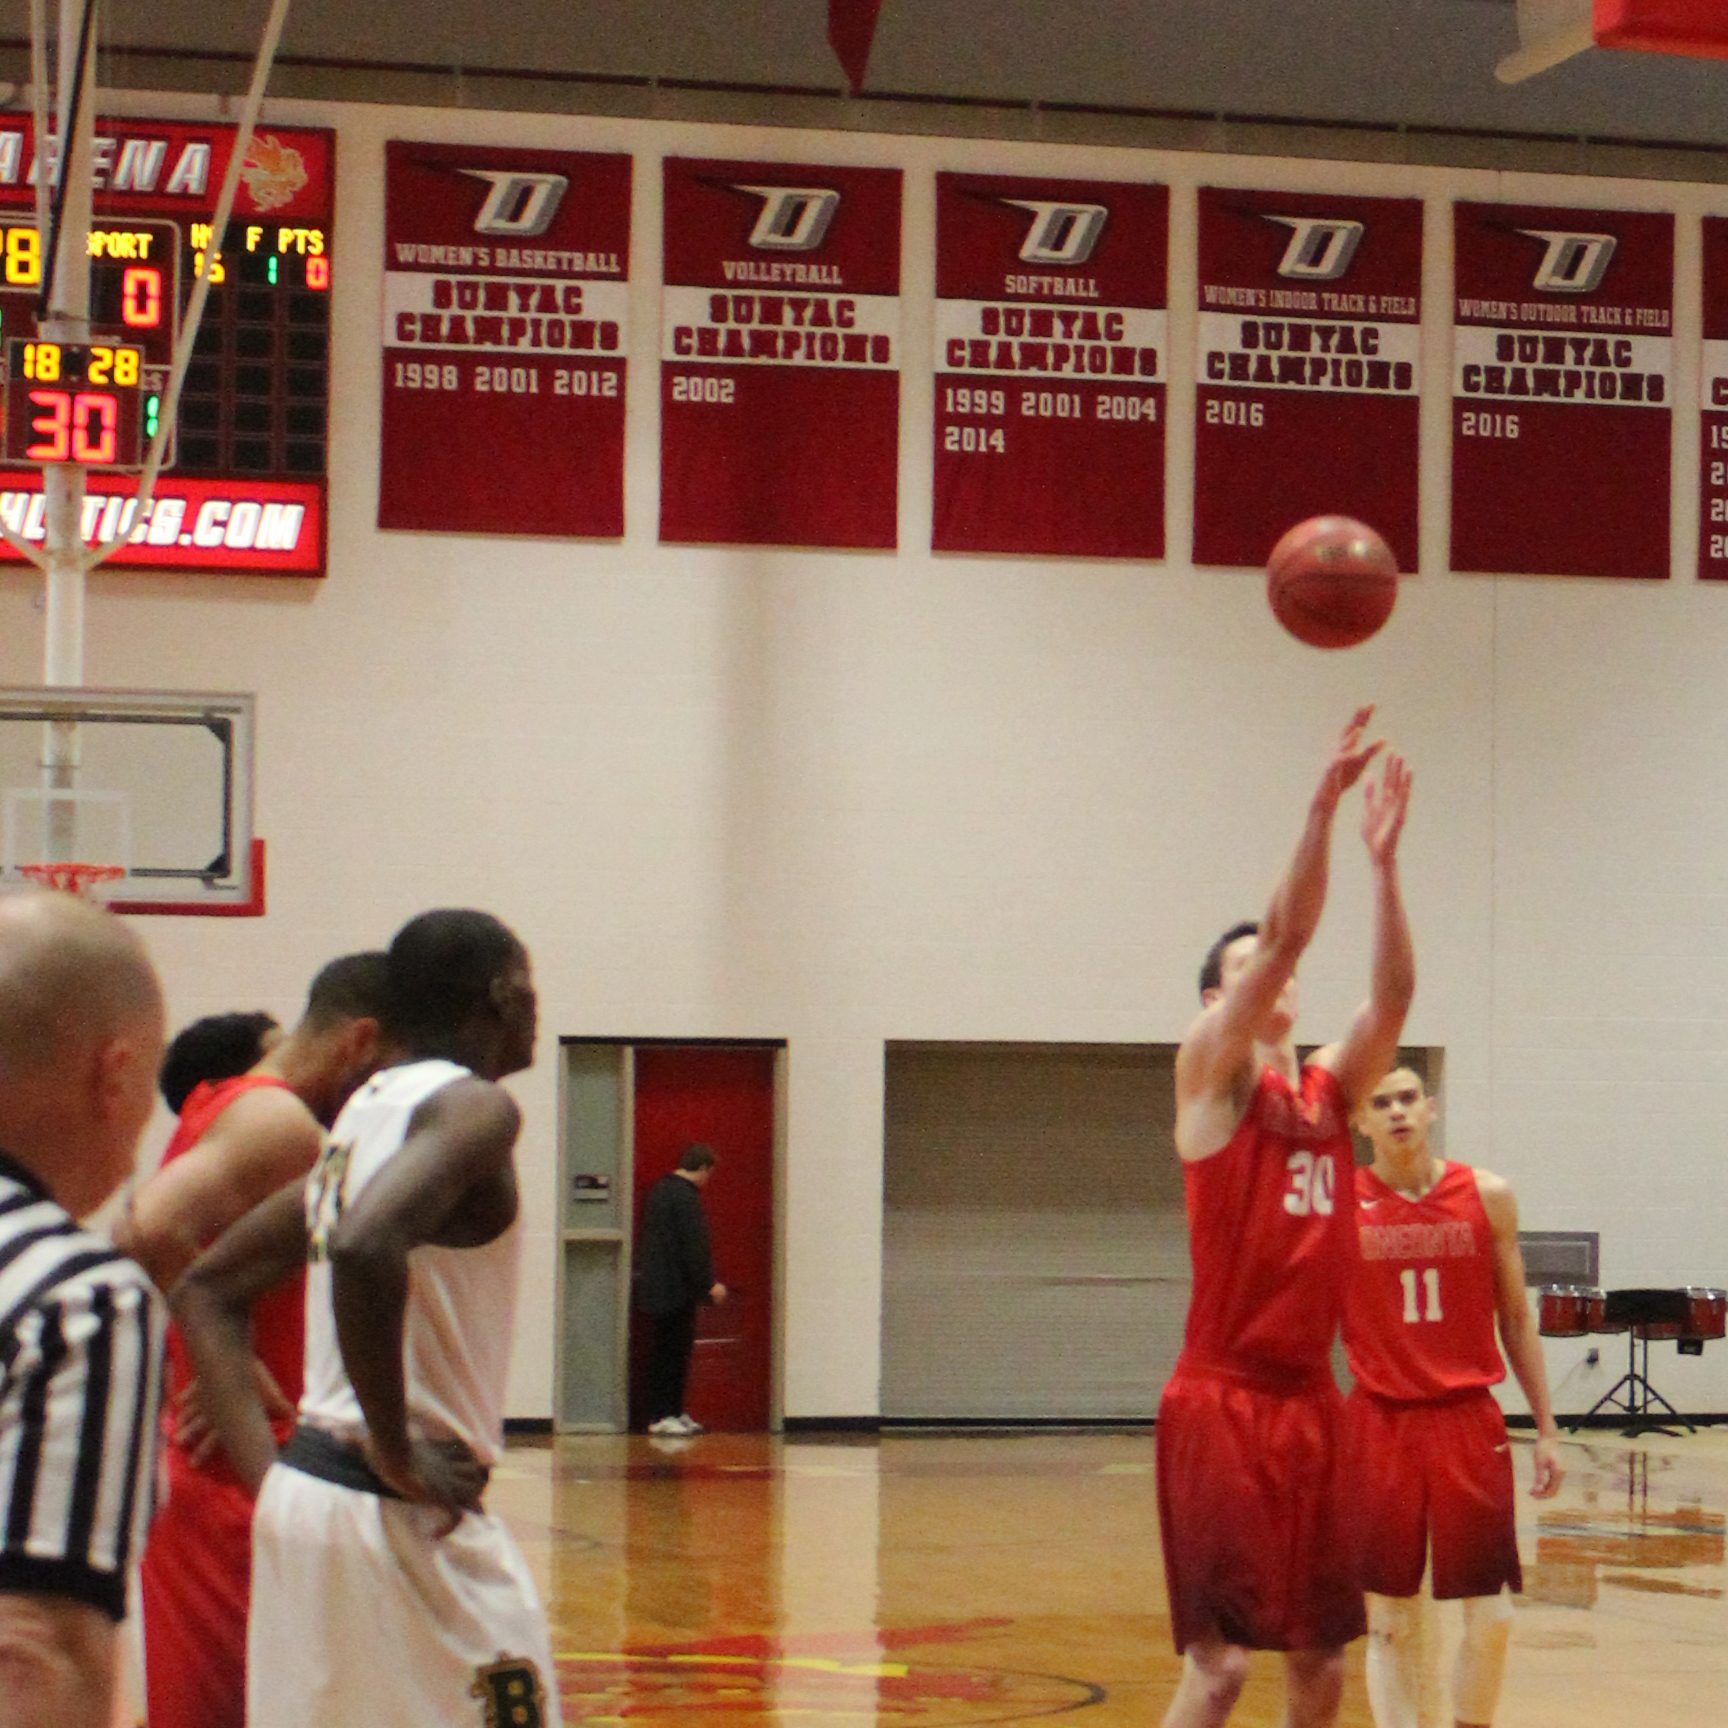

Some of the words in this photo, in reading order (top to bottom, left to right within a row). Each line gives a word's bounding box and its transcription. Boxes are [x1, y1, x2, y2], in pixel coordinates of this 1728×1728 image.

[246, 226, 263, 252] F
[278, 227, 324, 255] PTS
[305, 254, 329, 290] 0
[395, 243, 488, 269] WOMEN'S
[494, 247, 621, 274] BASKETBALL
[722, 261, 843, 285] VOLLEYBALL
[123, 266, 161, 328] 0
[432, 279, 583, 315] SUNYAC
[1005, 275, 1099, 298] SOFTBALL
[1204, 284, 1267, 307] WOMEN'S
[1320, 292, 1365, 314] TRACK
[1380, 295, 1417, 316] FIELD
[709, 293, 856, 328] SUNYAC
[981, 307, 1124, 342] SUNYAC
[1458, 297, 1518, 322] WOMEN'S
[1520, 301, 1577, 325] OUTDOOR
[1580, 304, 1622, 326] TRACK
[1635, 307, 1670, 329] FIELD
[395, 312, 620, 352] CHAMPIONS
[673, 326, 890, 364] CHAMPIONS
[1241, 321, 1379, 355] SUNYAC
[946, 338, 1158, 377] CHAMPIONS
[1496, 333, 1632, 368] SUNYAC
[394, 362, 458, 392] 1998
[474, 365, 539, 394] 2001
[553, 368, 618, 398] 2012
[1206, 350, 1413, 390] CHAMPIONS
[1461, 364, 1665, 402] CHAMPIONS
[672, 376, 735, 404] 2002
[945, 388, 1005, 414] 1999
[1021, 391, 1081, 419] 2001
[1096, 394, 1157, 422] 2004
[26, 390, 118, 464] 30
[1205, 399, 1264, 427] 2016
[1461, 412, 1520, 439] 2016
[944, 426, 1006, 454] 2014
[1283, 1150, 1336, 1217] 30
[1401, 1268, 1445, 1324] 11
